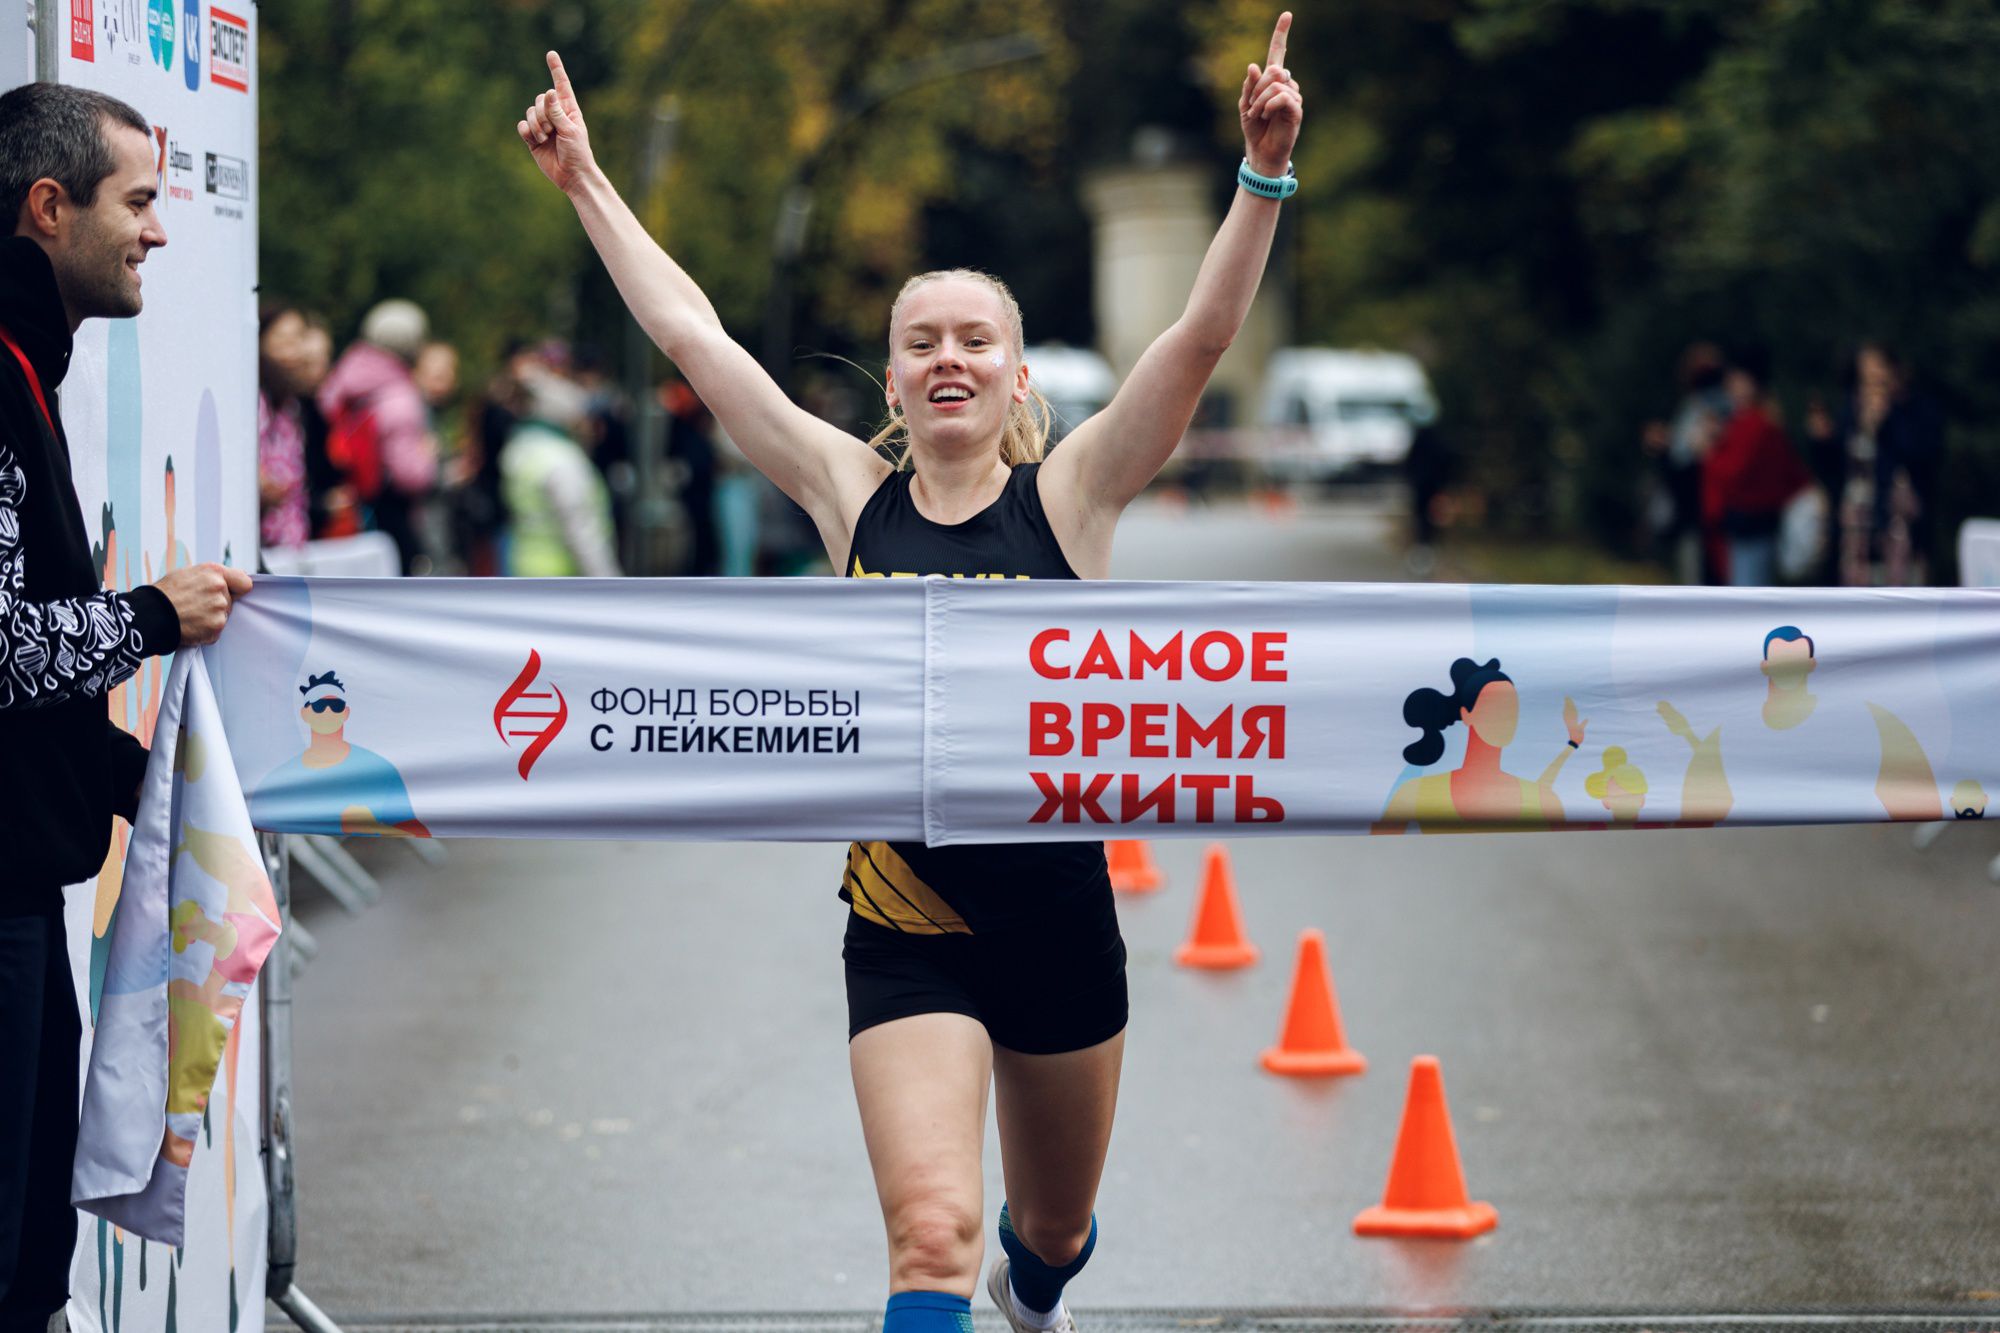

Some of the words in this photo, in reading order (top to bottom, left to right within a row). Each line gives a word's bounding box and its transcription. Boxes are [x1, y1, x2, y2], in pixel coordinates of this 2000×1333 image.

[1029, 627, 1288, 682] САМОЕ
[590, 687, 698, 721] ФОНД
[709, 688, 860, 717] БОРЬБЫ
[590, 724, 614, 752] С
[630, 718, 860, 754] ЛЕЙКЕМИЕЙ
[1029, 702, 1286, 759] ВРЕМЯ
[1027, 772, 1286, 824] ЖИТЬ
